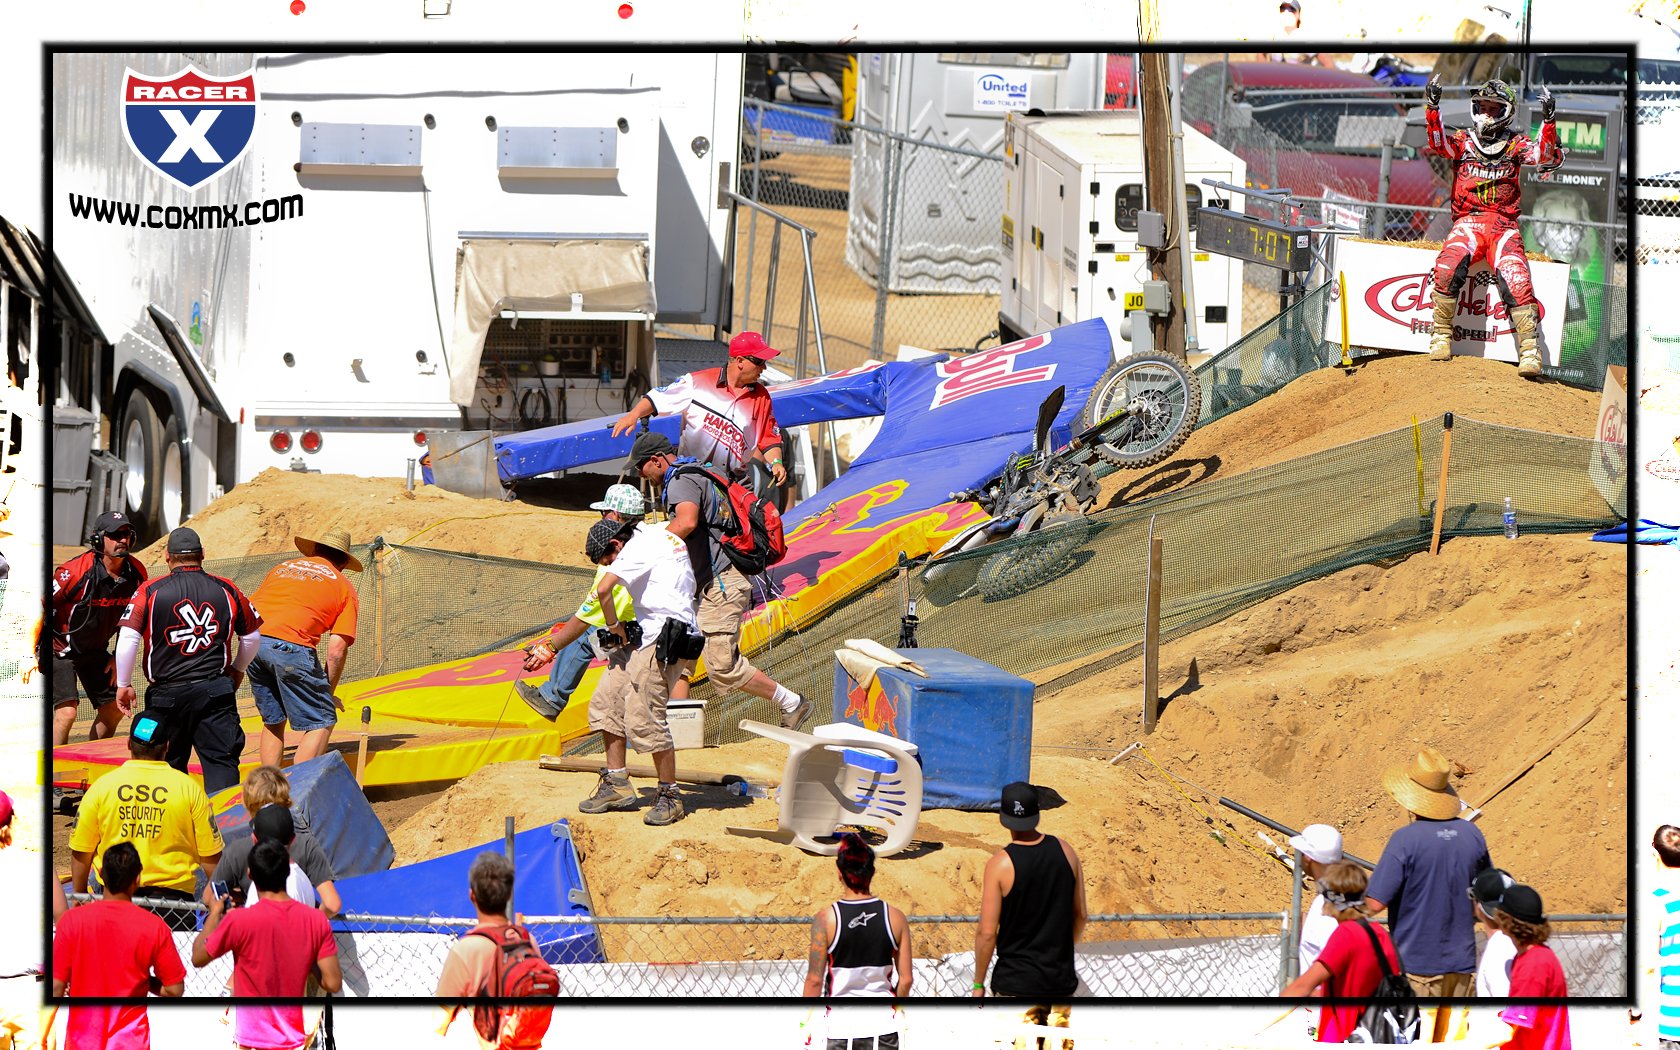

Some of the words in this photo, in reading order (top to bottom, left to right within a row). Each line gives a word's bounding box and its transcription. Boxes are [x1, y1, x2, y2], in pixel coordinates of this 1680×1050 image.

[983, 80, 1027, 92] United
[1250, 226, 1292, 264] 7:07
[117, 784, 169, 805] CSC
[118, 805, 166, 822] SECURITY
[121, 823, 162, 839] STAFF
